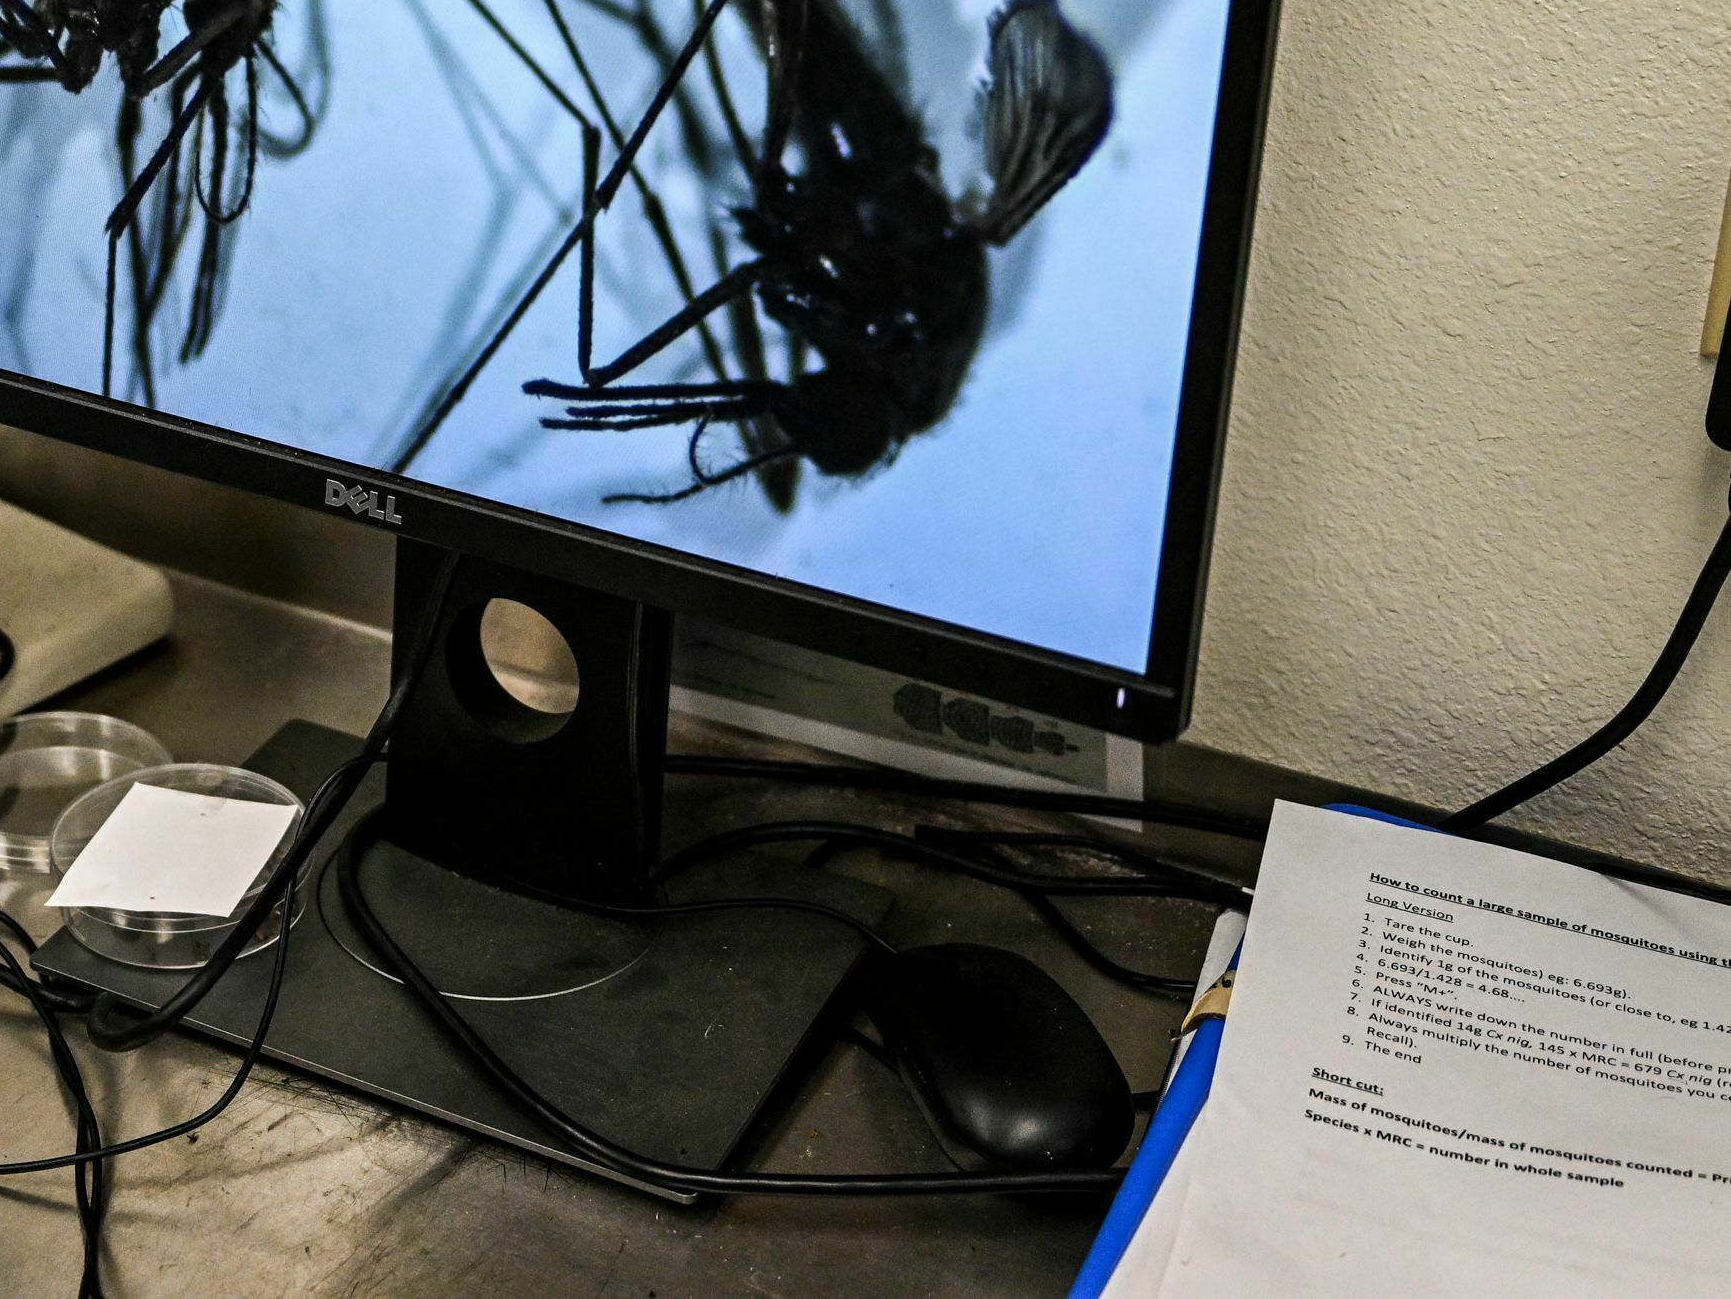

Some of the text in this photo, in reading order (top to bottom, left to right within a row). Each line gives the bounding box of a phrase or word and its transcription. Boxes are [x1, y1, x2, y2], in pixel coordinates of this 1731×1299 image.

[324, 478, 403, 525] DELL
[1363, 913, 1474, 948] 1. Tare the cup.
[1367, 892, 1454, 921] Long Version
[1370, 872, 1402, 887] How
[1405, 882, 1420, 892] to
[1423, 887, 1463, 903] count
[1466, 897, 1475, 906] a
[1478, 898, 1514, 915] large
[1517, 908, 1568, 928] sample
[1572, 924, 1588, 933] of
[1591, 928, 1675, 954] mosquitoes
[1679, 949, 1718, 966] using
[1354, 966, 1367, 976] 5.
[1375, 971, 1413, 988] Press
[1356, 953, 1369, 962] 4.
[1377, 958, 1463, 987] 6.693/1.428
[1358, 939, 1371, 949] 3.
[1380, 945, 1433, 966] Identify
[1438, 960, 1453, 972] 1g
[1457, 962, 1473, 974] of
[1475, 968, 1499, 982] the
[1503, 977, 1586, 1003] mosquitoes
[1590, 996, 1612, 1008] (or
[1615, 1003, 1652, 1018] close
[1656, 1012, 1676, 1024] to,
[1680, 1017, 1698, 1029] eg
[1360, 926, 1631, 1000] 2. Weigh the mosquitoes) eg: 6.693g).
[1341, 1034, 1422, 1064] 9. The end
[1346, 1006, 1359, 1016] 8.
[1368, 1012, 1418, 1034] Always
[1422, 1028, 1481, 1051] multiply
[1484, 1044, 1509, 1057] the
[1513, 1048, 1571, 1071] number
[1575, 1066, 1592, 1076] of
[1595, 1069, 1683, 1093] mosquitoes
[1687, 1087, 1715, 1099] you
[1349, 992, 1362, 1003] 7.
[1371, 998, 1382, 1007] If
[1385, 1001, 1452, 1028] identified
[1456, 1022, 1483, 1037] 14g
[1486, 1029, 1504, 1040] Cx
[1507, 1035, 1533, 1050] nig,
[1539, 1042, 1565, 1055] 145
[1569, 1050, 1578, 1058] x
[1582, 1051, 1617, 1066] MRC
[1634, 1063, 1663, 1075] 679
[1667, 1069, 1685, 1080] Cx
[1689, 1074, 1713, 1086] nig
[1351, 979, 1364, 989] 6.
[1373, 985, 1432, 1007] ALWAYS
[1435, 1003, 1473, 1018] write
[1477, 1013, 1517, 1029] down
[1521, 1023, 1545, 1036] the
[1550, 1030, 1608, 1050] number
[1612, 1043, 1625, 1054] in
[1630, 1047, 1654, 1060] full
[1657, 1053, 1713, 1072] (before
[1367, 1026, 1417, 1048] Recall).
[1313, 1067, 1352, 1086] Short
[1305, 1109, 1359, 1133] Species
[1363, 1128, 1372, 1137] x
[1376, 1130, 1412, 1148] MRC
[1429, 1146, 1491, 1166] number
[1495, 1158, 1509, 1170] in
[1513, 1162, 1562, 1178] whole
[1567, 1171, 1624, 1189] sample
[1309, 1087, 1347, 1106] Mass
[1351, 1102, 1367, 1111] of
[1370, 1106, 1505, 1148] mosquitoes/mass
[1509, 1142, 1526, 1152] of
[1530, 1145, 1622, 1167] mosquitoes
[1626, 1161, 1693, 1179] counted
